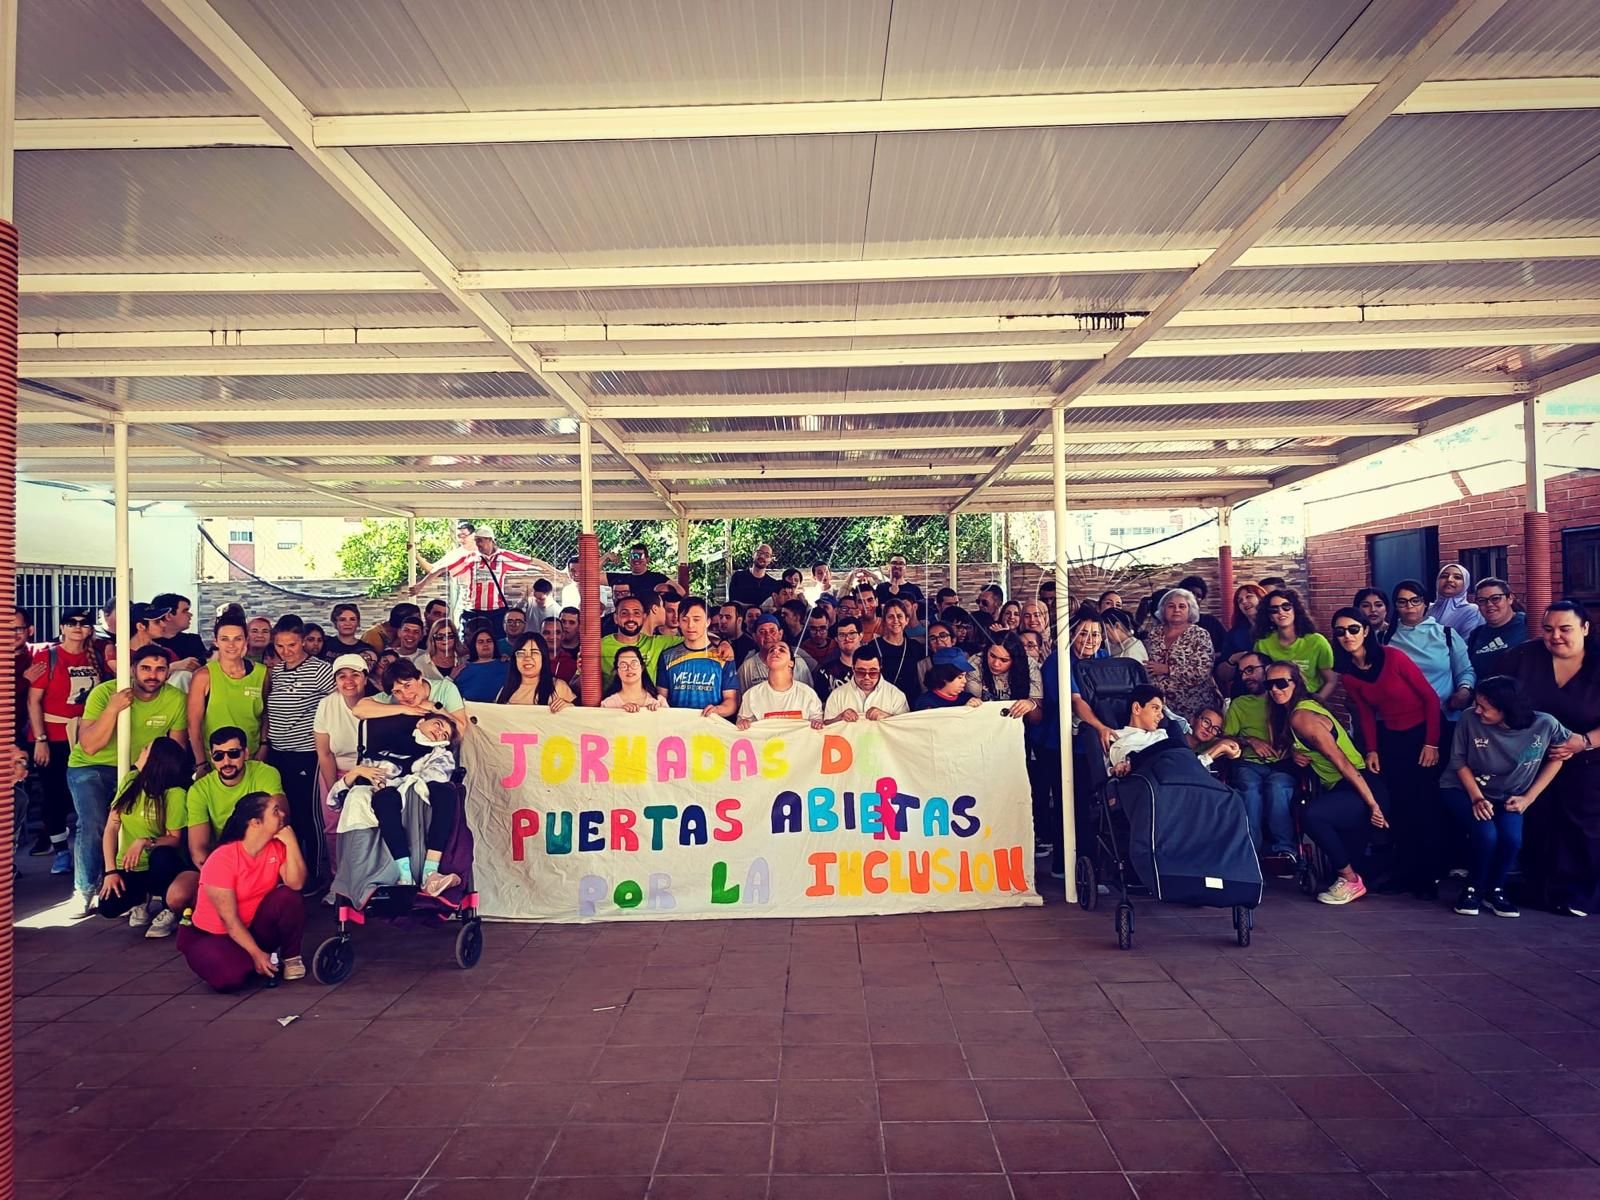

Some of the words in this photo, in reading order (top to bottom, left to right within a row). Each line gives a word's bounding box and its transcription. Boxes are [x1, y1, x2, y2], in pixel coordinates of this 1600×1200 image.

[673, 672, 716, 686] MELILLA
[499, 732, 790, 789] JORNADAS
[819, 733, 885, 776] DE
[511, 798, 744, 862] PUERTAS
[579, 872, 678, 917] POR
[711, 857, 772, 905] LA
[805, 845, 1030, 898] INCLUSION
